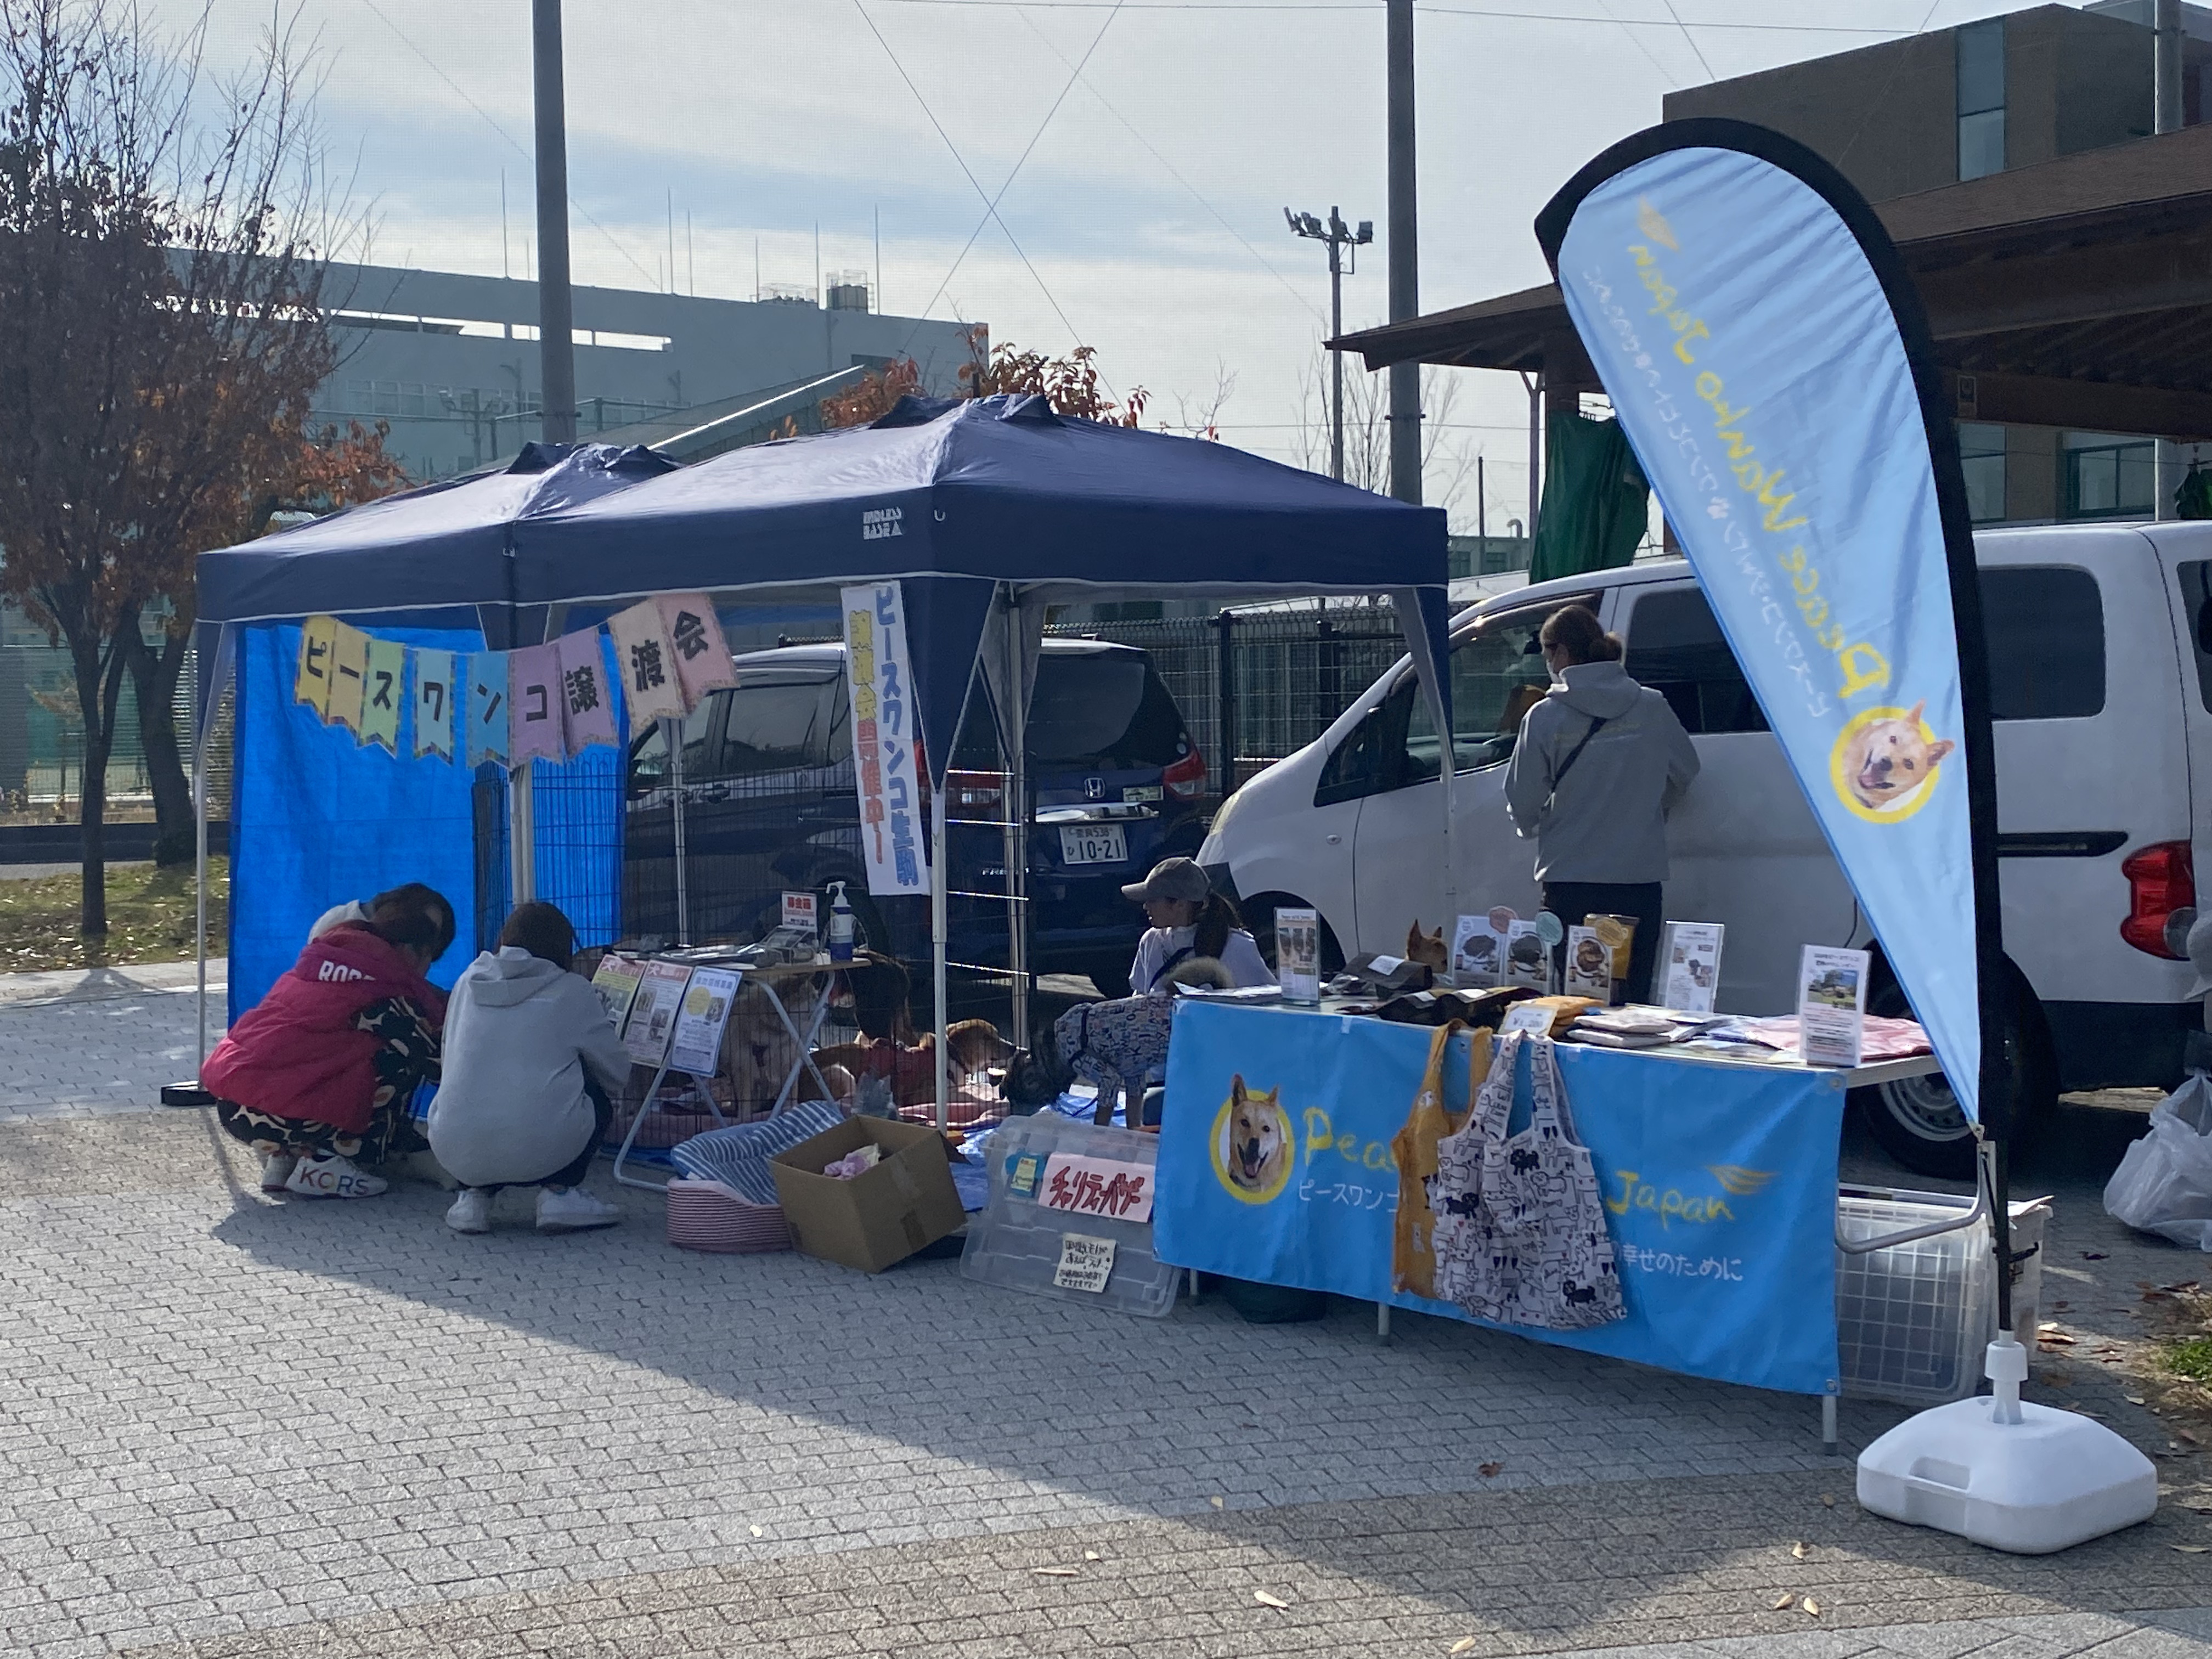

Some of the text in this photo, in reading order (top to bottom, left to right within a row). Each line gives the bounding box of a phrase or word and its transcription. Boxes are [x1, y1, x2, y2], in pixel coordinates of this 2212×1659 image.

[306, 610, 709, 724] ピースワンコ譲渡会
[1079, 839, 1121, 860] 10-21
[300, 1167, 369, 1195] KORS
[1606, 1170, 1735, 1230] Japan
